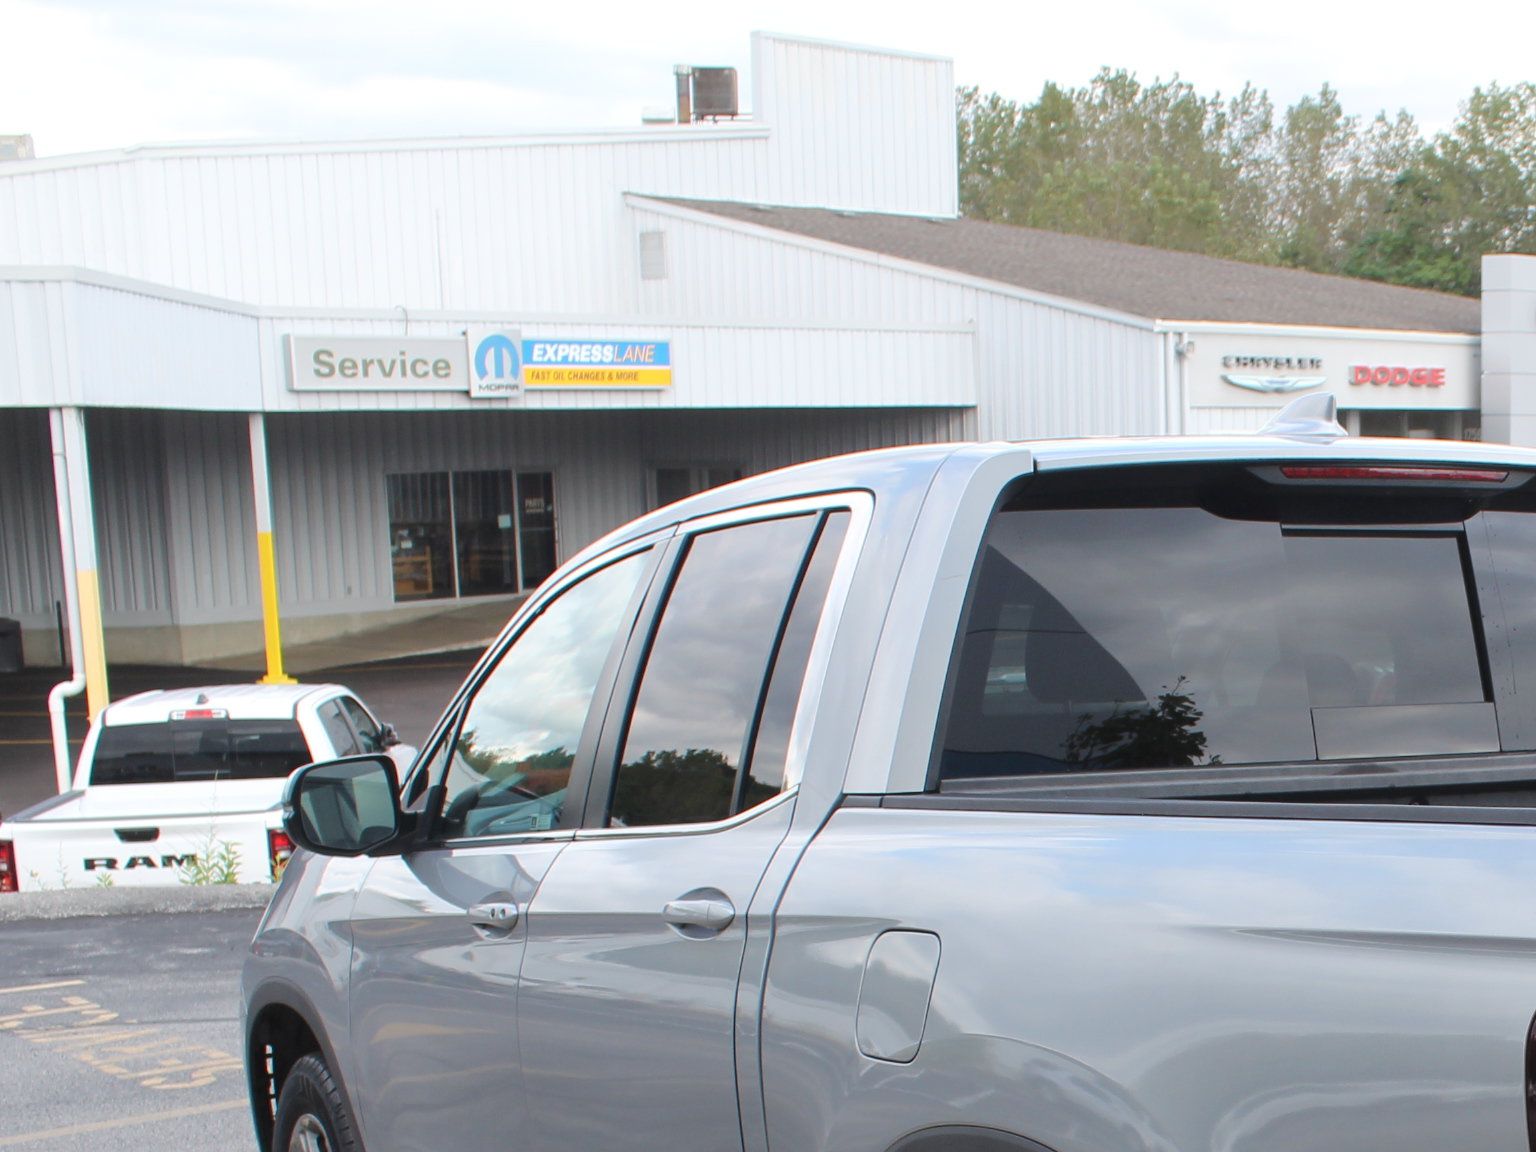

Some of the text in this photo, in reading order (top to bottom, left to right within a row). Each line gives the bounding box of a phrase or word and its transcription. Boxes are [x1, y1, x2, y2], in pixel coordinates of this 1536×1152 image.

[312, 349, 452, 380] Service
[1222, 355, 1323, 370] CHRYSLER
[530, 370, 640, 382] FAST OIL CHANGES & MORE
[1349, 364, 1446, 388] DODGE
[478, 383, 519, 393] MOPAR
[84, 853, 198, 872] RAM
